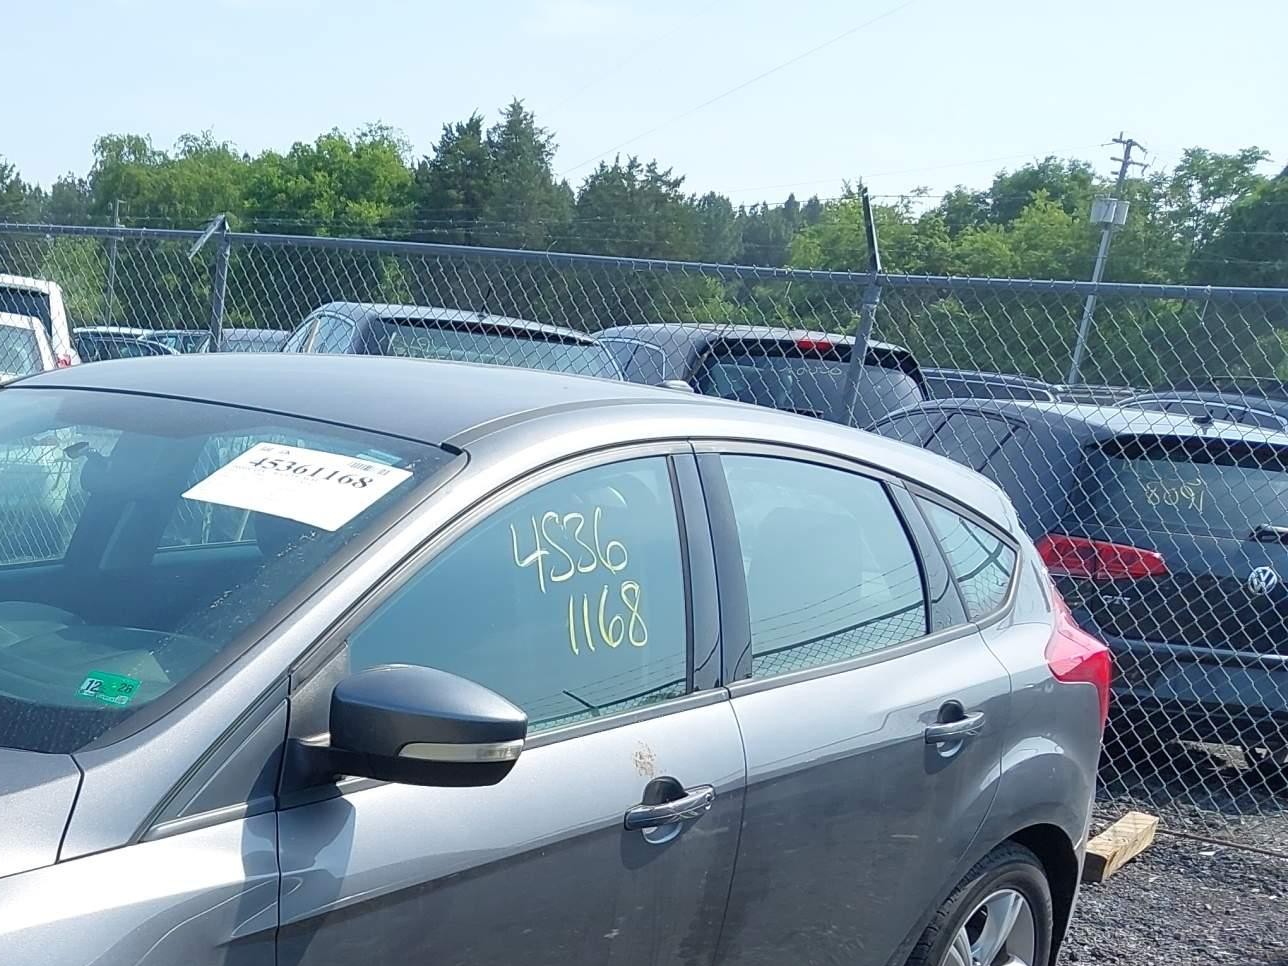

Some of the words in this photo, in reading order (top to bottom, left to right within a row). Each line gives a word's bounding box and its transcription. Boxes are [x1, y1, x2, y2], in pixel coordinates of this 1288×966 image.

[248, 457, 374, 489] 45361168
[510, 507, 628, 594] 4536
[568, 580, 649, 656] 1168
[85, 679, 103, 693] 12
